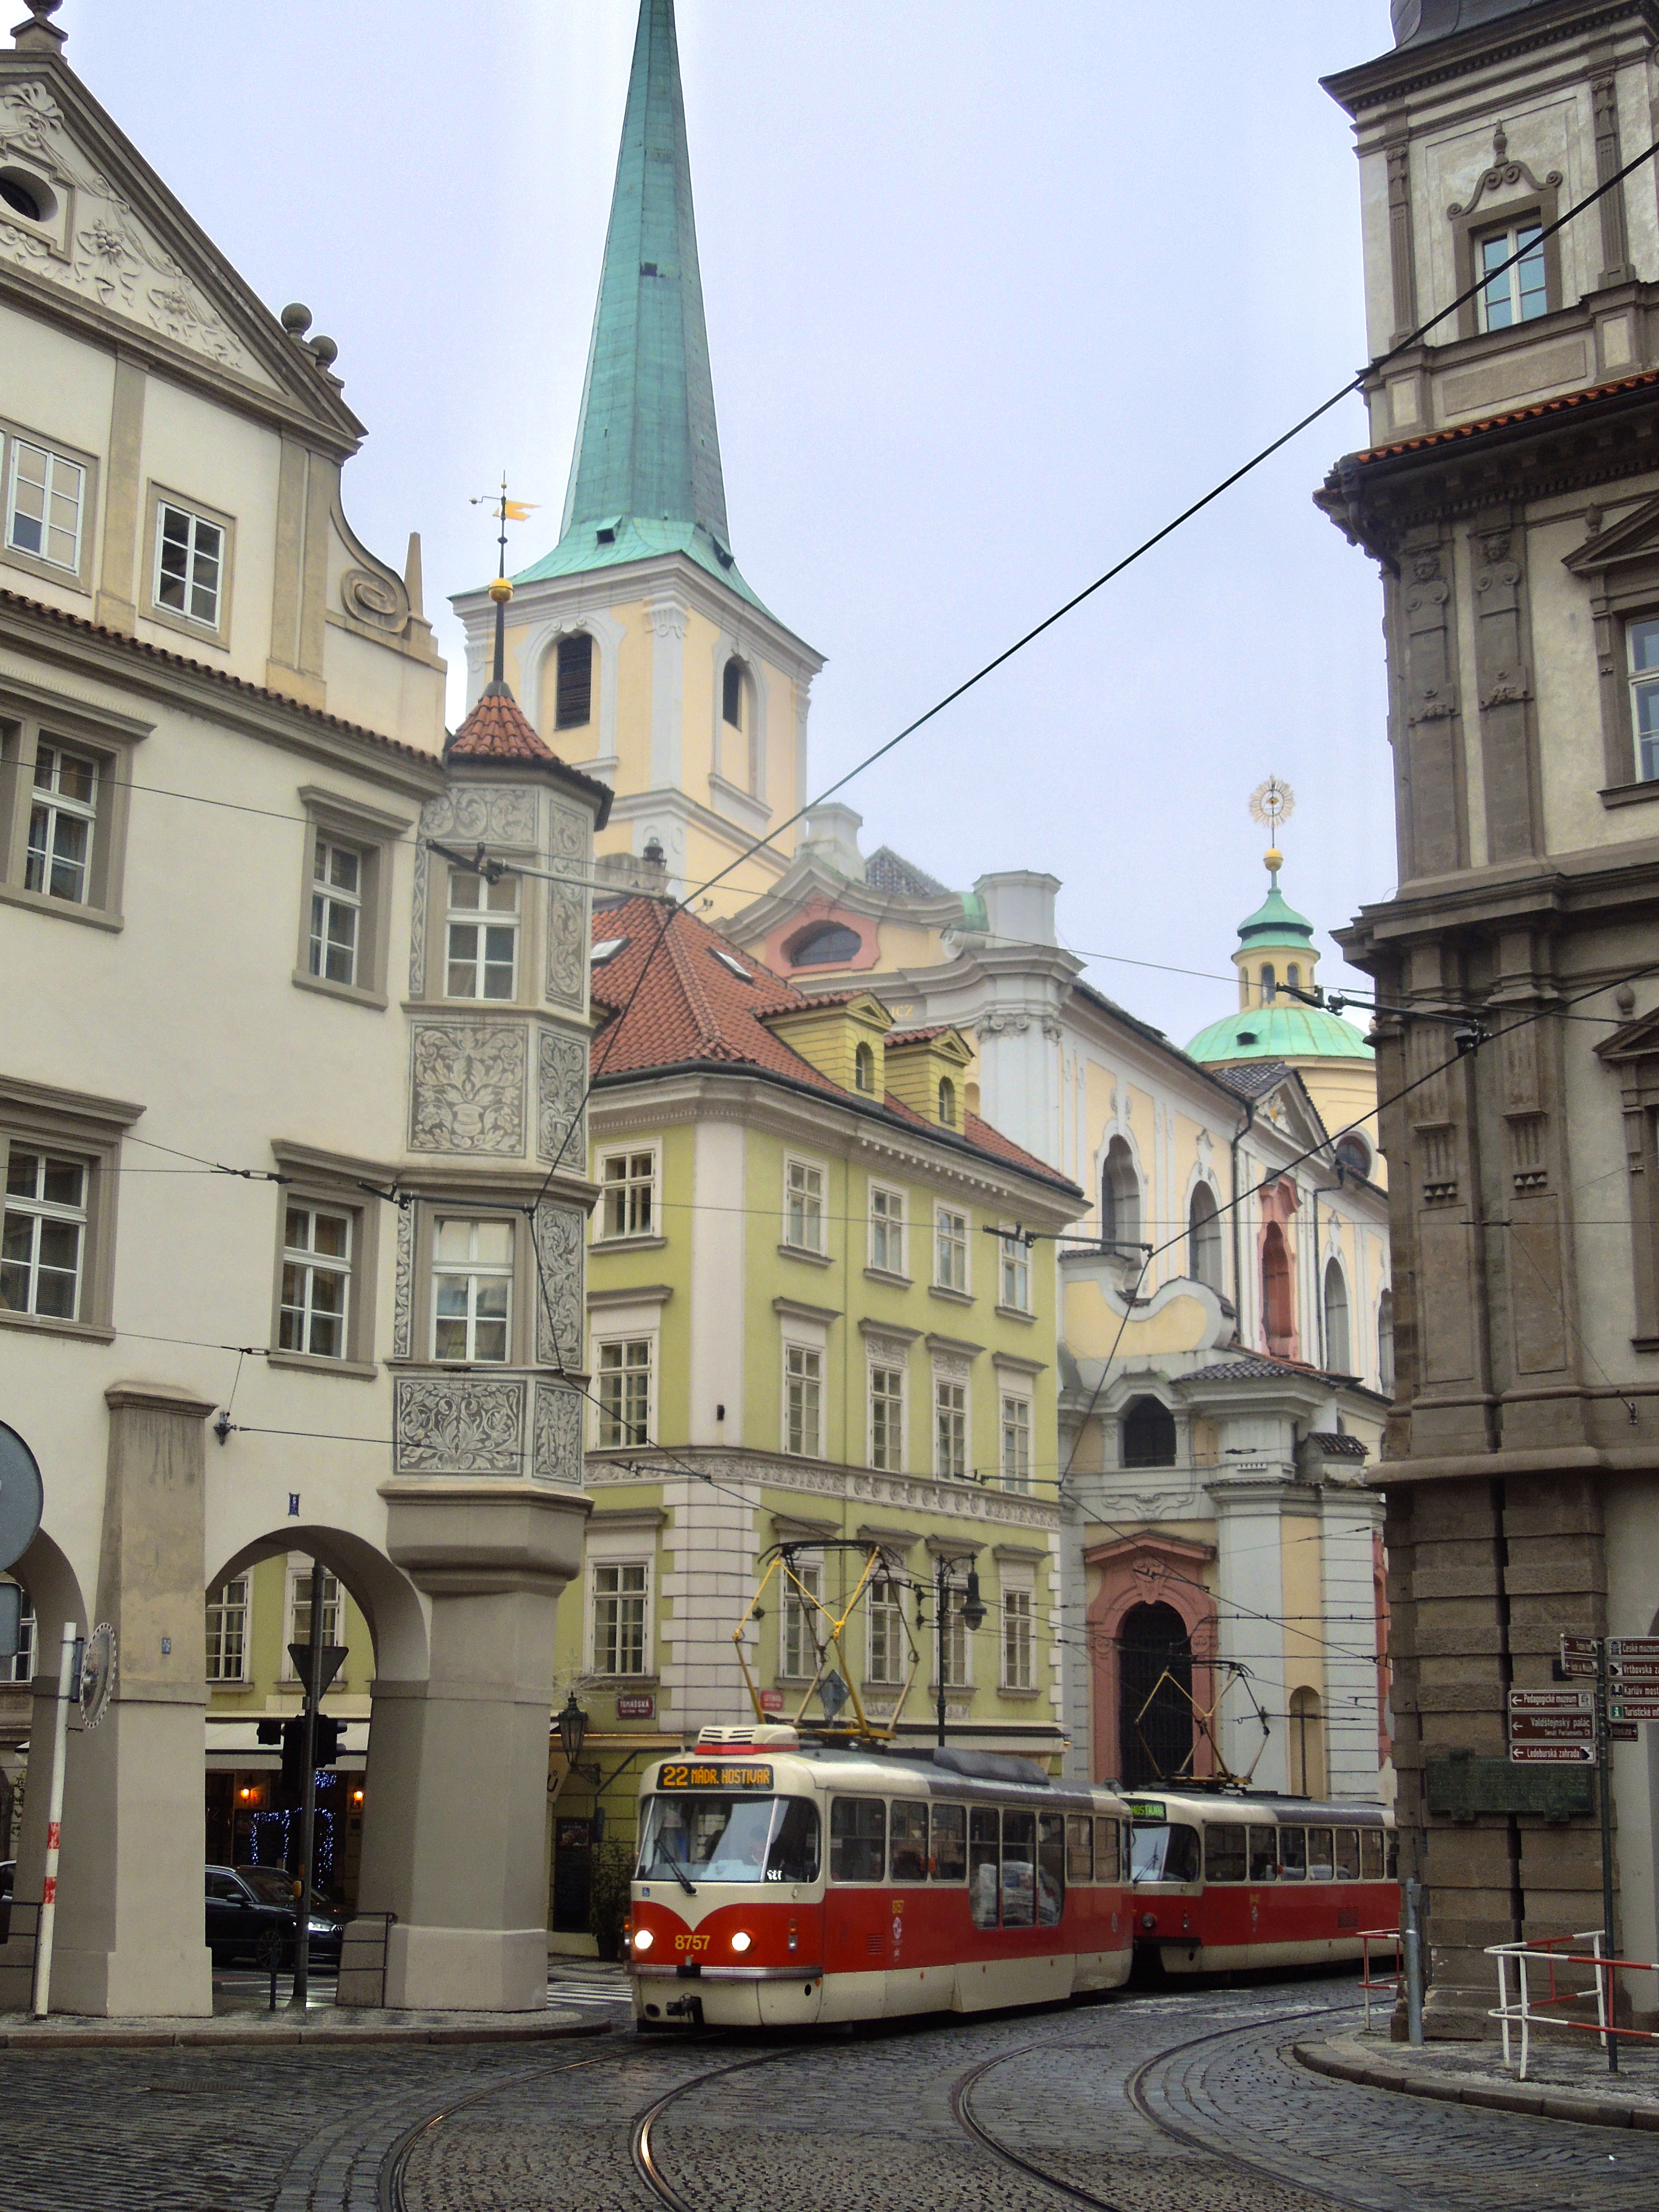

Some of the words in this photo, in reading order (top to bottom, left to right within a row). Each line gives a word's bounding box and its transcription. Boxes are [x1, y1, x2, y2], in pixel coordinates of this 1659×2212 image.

[1623, 1664, 1652, 1674] Vrtbovská
[1624, 1683, 1642, 1695] Karlův
[1624, 1707, 1651, 1717] Turistické
[1531, 1717, 1570, 1729] Valdštejnský
[1573, 1717, 1590, 1729] palác
[1527, 1748, 1557, 1758] Ledeburská
[1559, 1748, 1580, 1758] zahrada
[663, 1766, 688, 1786] 22
[674, 1935, 710, 1950] 8757
